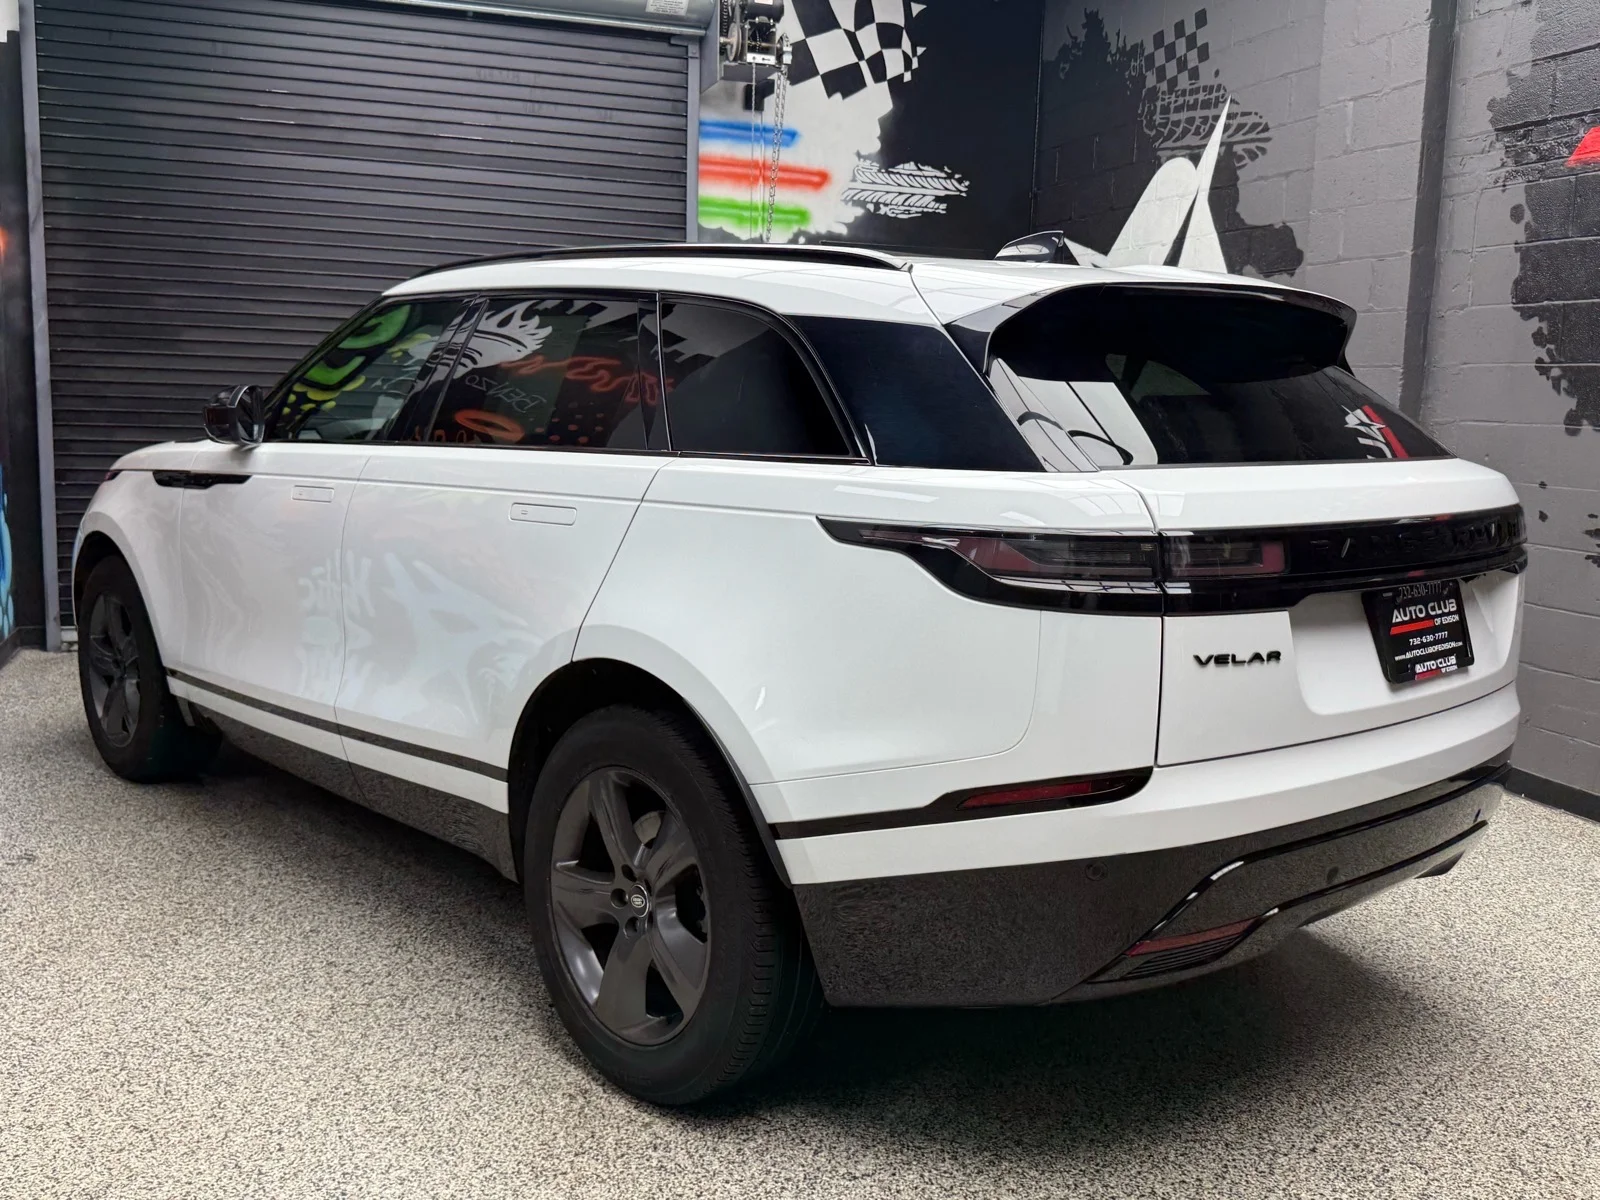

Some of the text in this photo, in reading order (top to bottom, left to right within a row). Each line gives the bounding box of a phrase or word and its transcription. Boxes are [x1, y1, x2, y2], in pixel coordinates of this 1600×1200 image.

[1392, 598, 1457, 623] AUTO CLUB
[1434, 614, 1459, 626] OF EDISON
[1409, 631, 1448, 646] 732-630-7777
[1193, 651, 1281, 666] VELAR
[1415, 656, 1456, 673] AUTO CLUB
